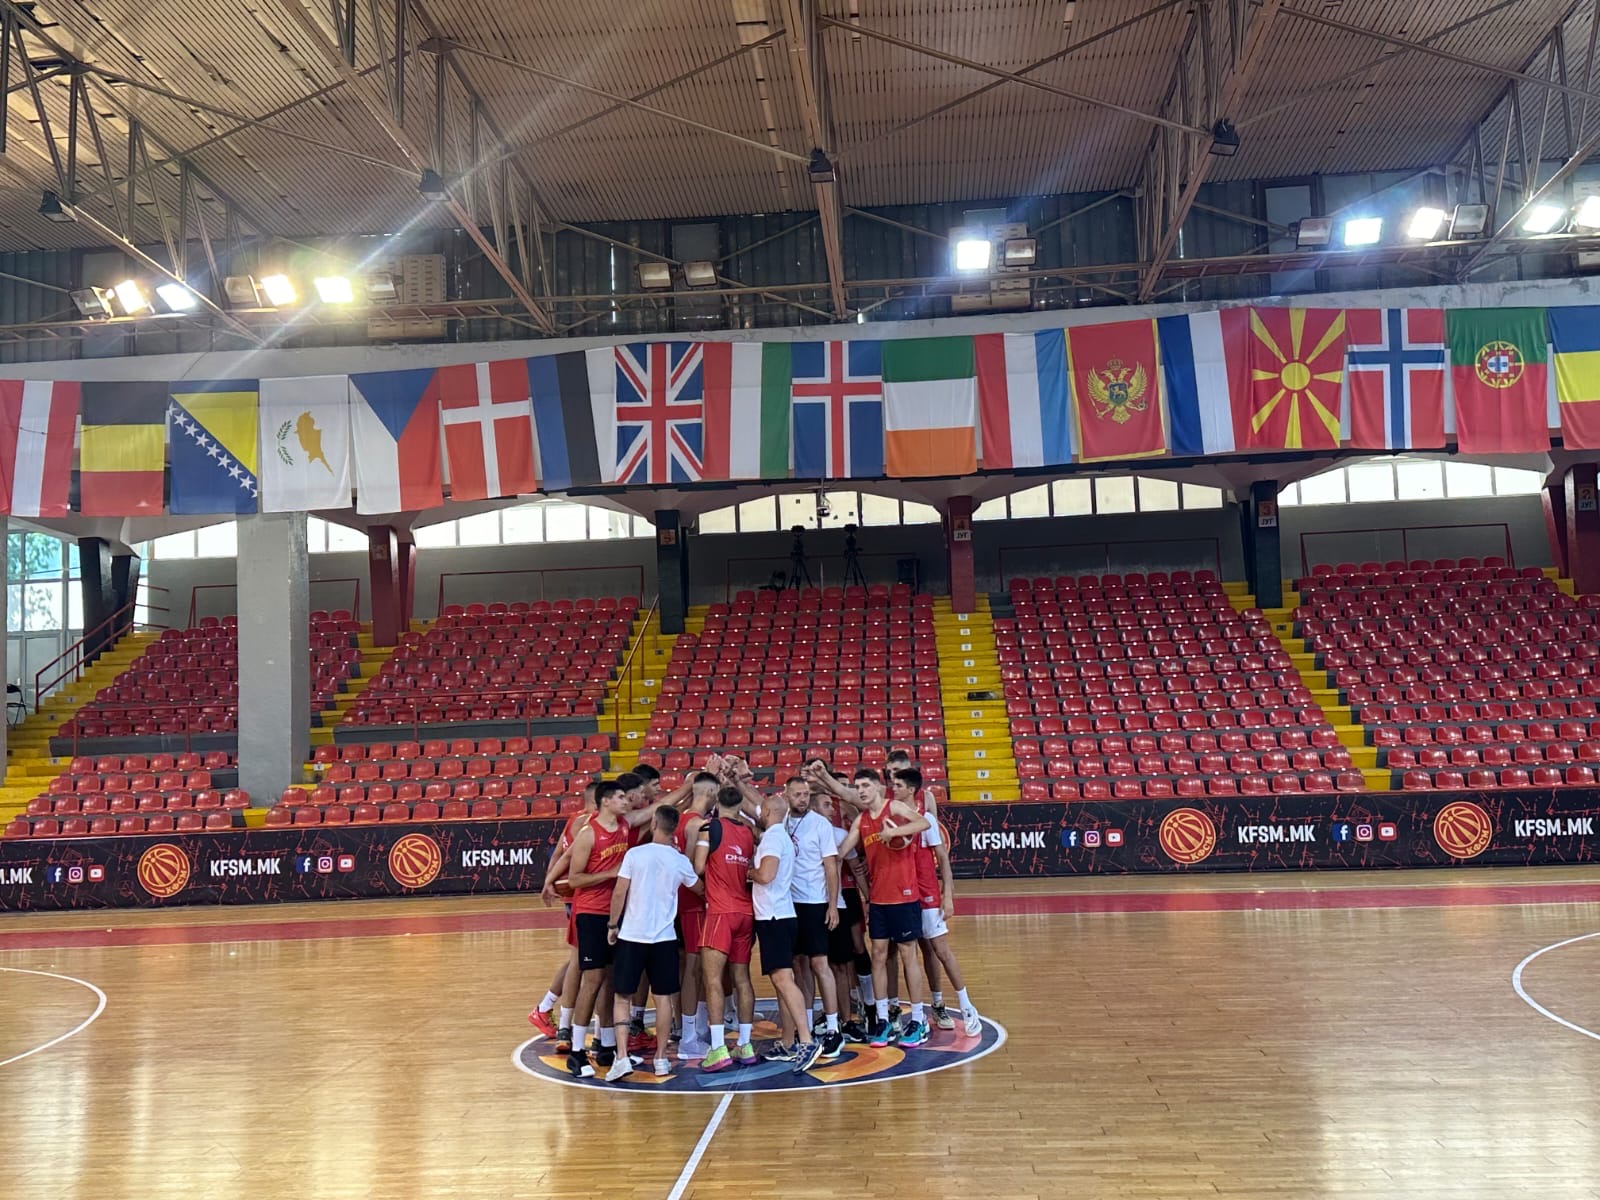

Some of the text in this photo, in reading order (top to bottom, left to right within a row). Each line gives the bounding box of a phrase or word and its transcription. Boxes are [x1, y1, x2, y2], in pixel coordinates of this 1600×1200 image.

[1237, 824, 1316, 844] KFSM.MK
[1514, 818, 1594, 837] KFSM.MK
[971, 831, 1046, 850] KFSM.MK
[210, 857, 281, 877] KFSM.MK
[462, 848, 534, 868] KFSM.MK
